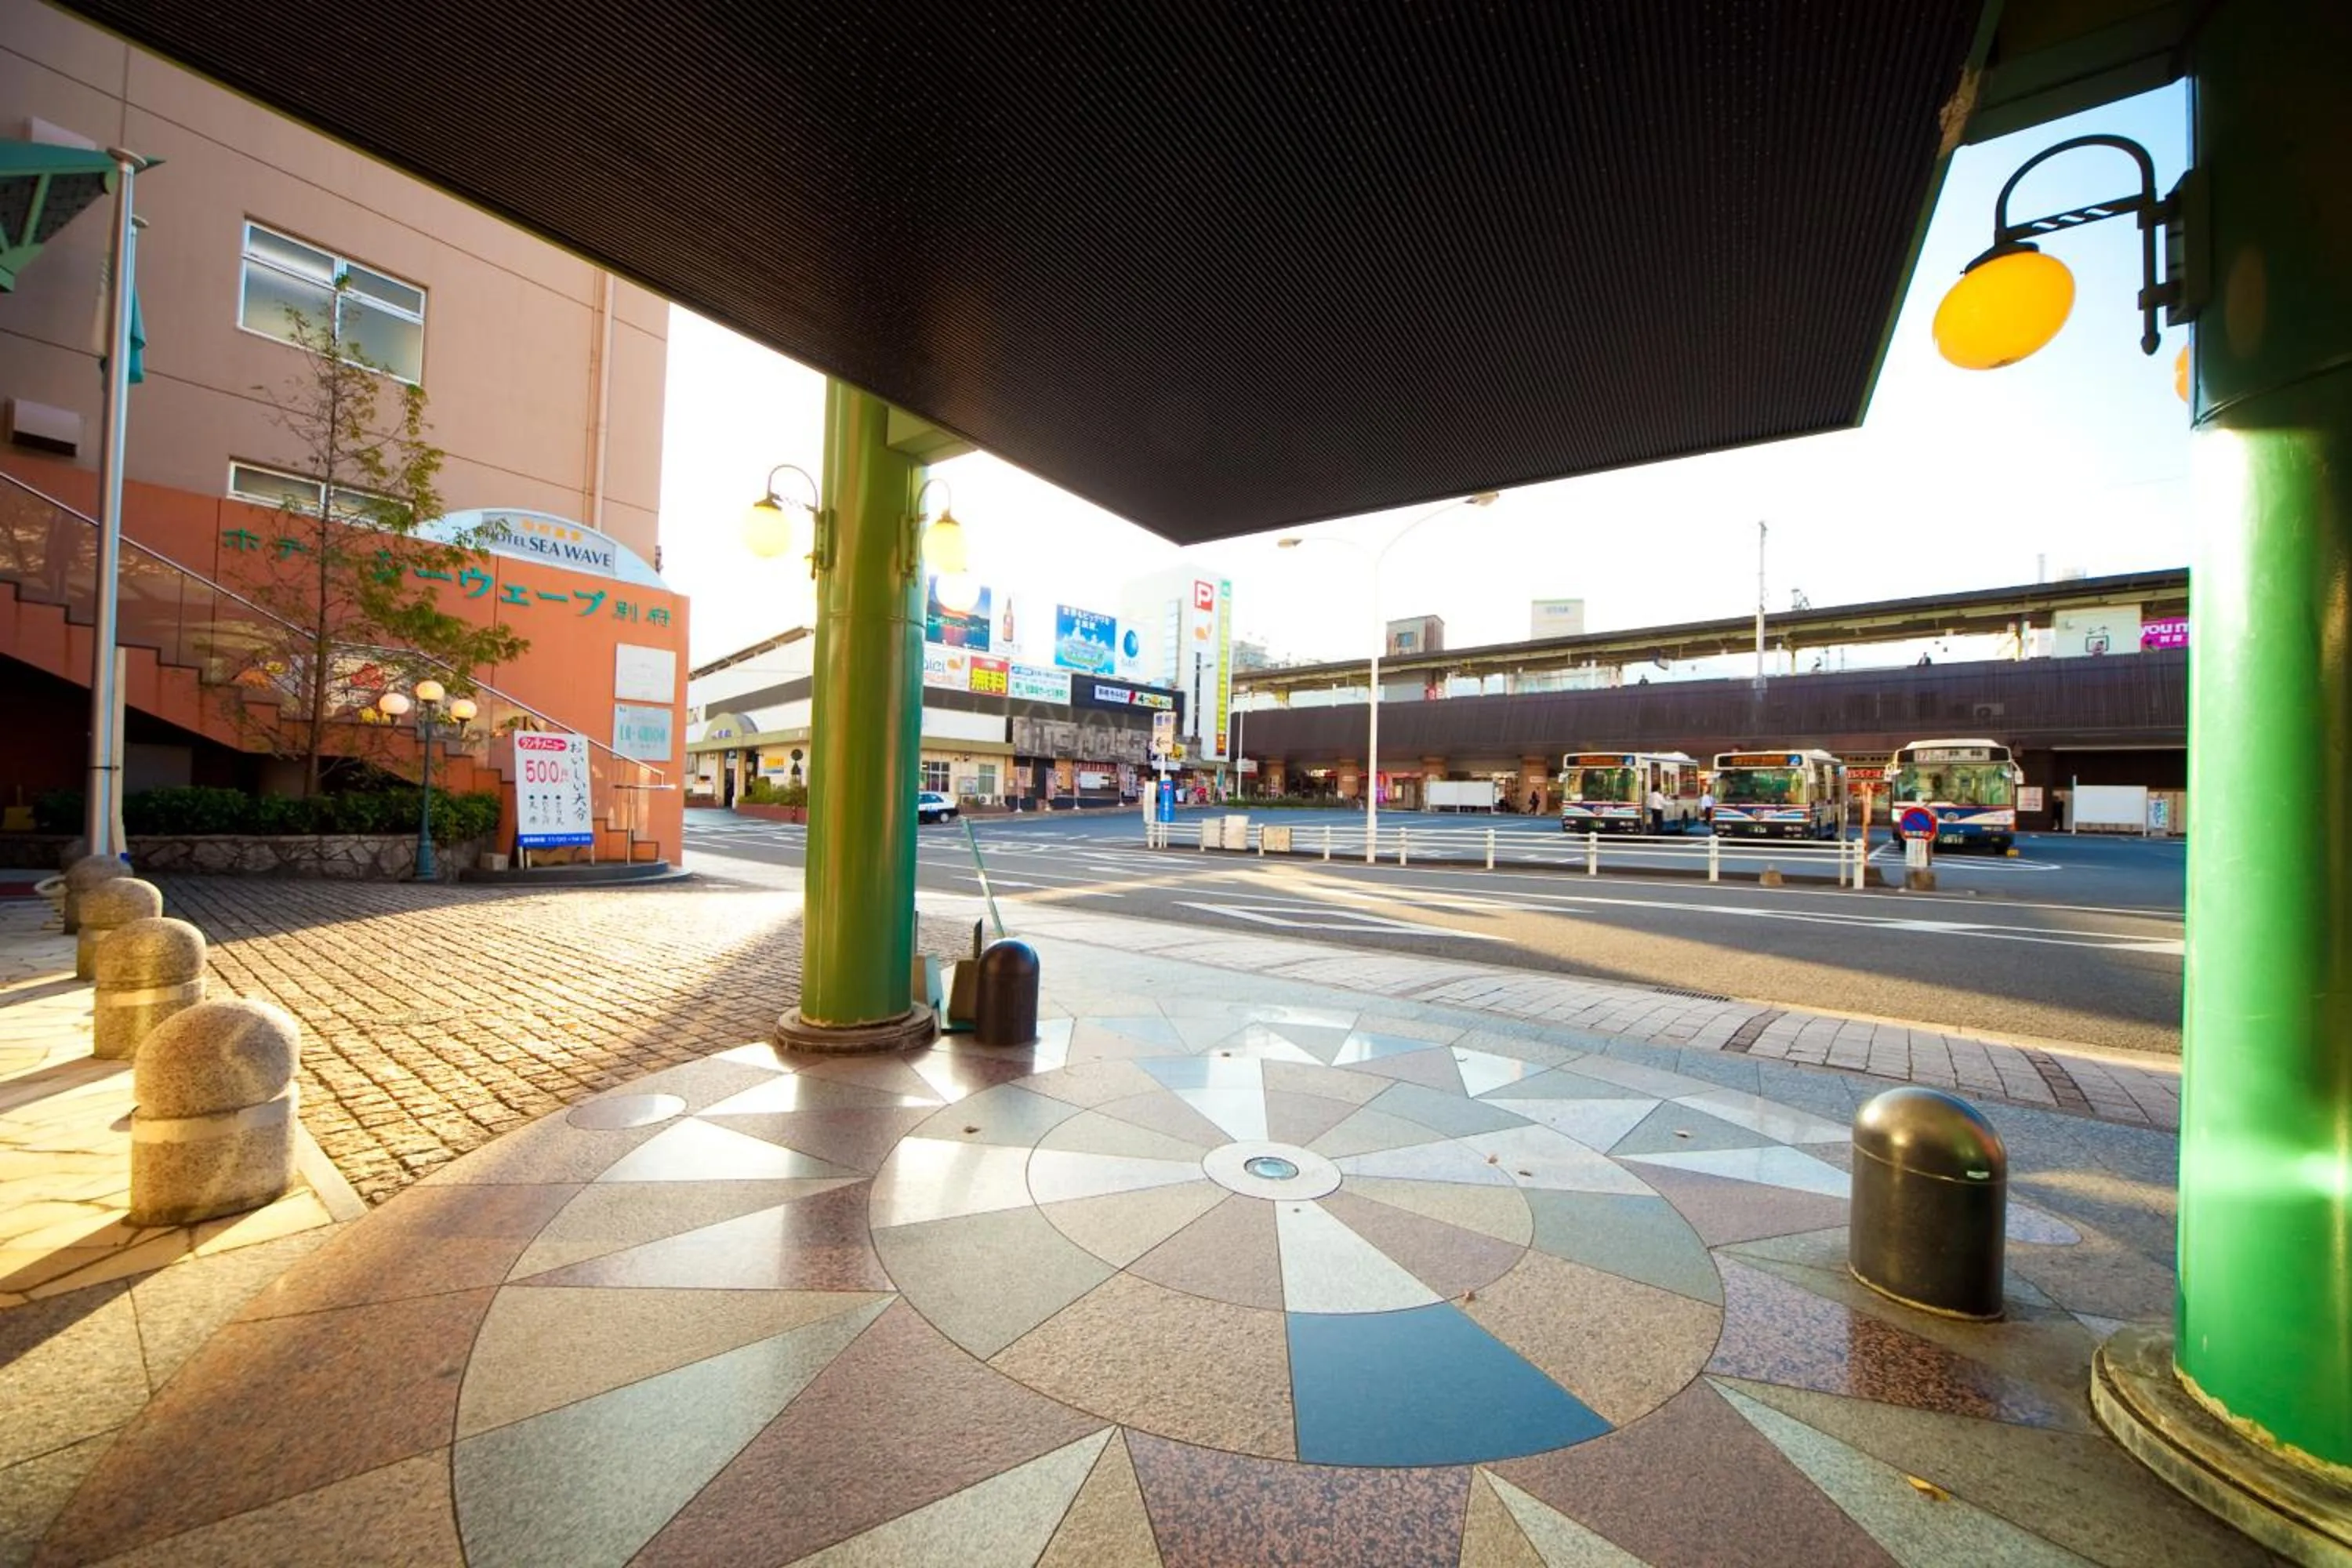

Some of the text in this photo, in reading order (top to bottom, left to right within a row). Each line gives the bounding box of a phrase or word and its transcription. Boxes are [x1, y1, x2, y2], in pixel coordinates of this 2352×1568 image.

[529, 536, 560, 557] SEA
[564, 545, 612, 568] WAVE
[1196, 585, 1211, 606] P
